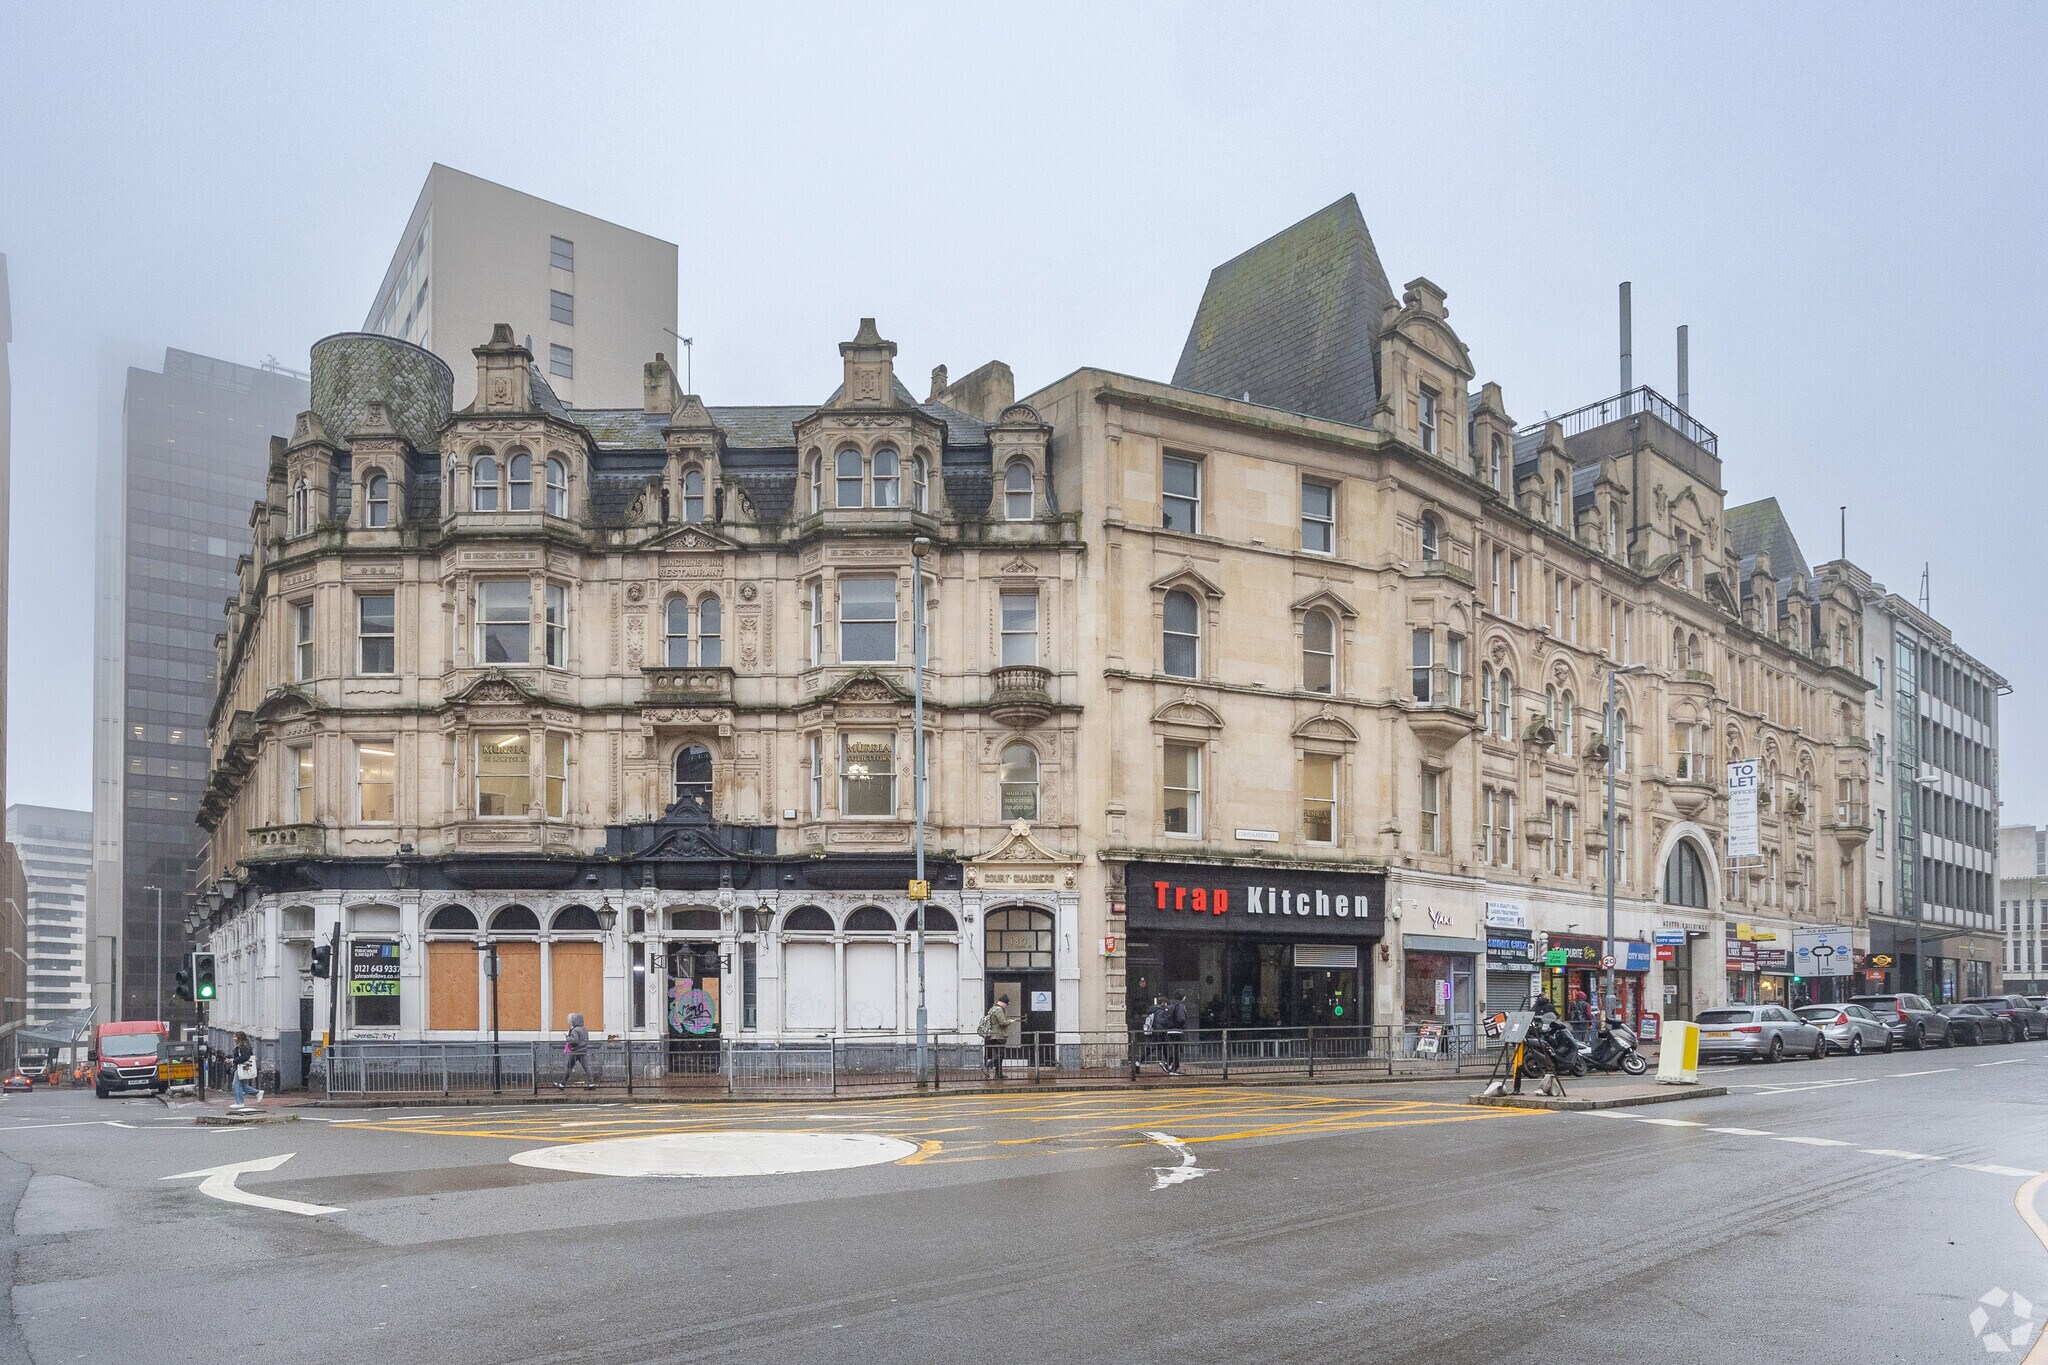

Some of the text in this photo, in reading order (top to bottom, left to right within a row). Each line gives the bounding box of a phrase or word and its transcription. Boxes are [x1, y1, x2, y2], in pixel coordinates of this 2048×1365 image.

[661, 559, 723, 567] LINCOLNS INN
[660, 569, 724, 577] RESTAURANT
[1733, 765, 1753, 776] TO
[1730, 776, 1756, 788] LET
[1154, 881, 1368, 917] Trap Kitchen
[1638, 953, 1650, 961] NEWS
[354, 965, 400, 973] 0121 643 9337
